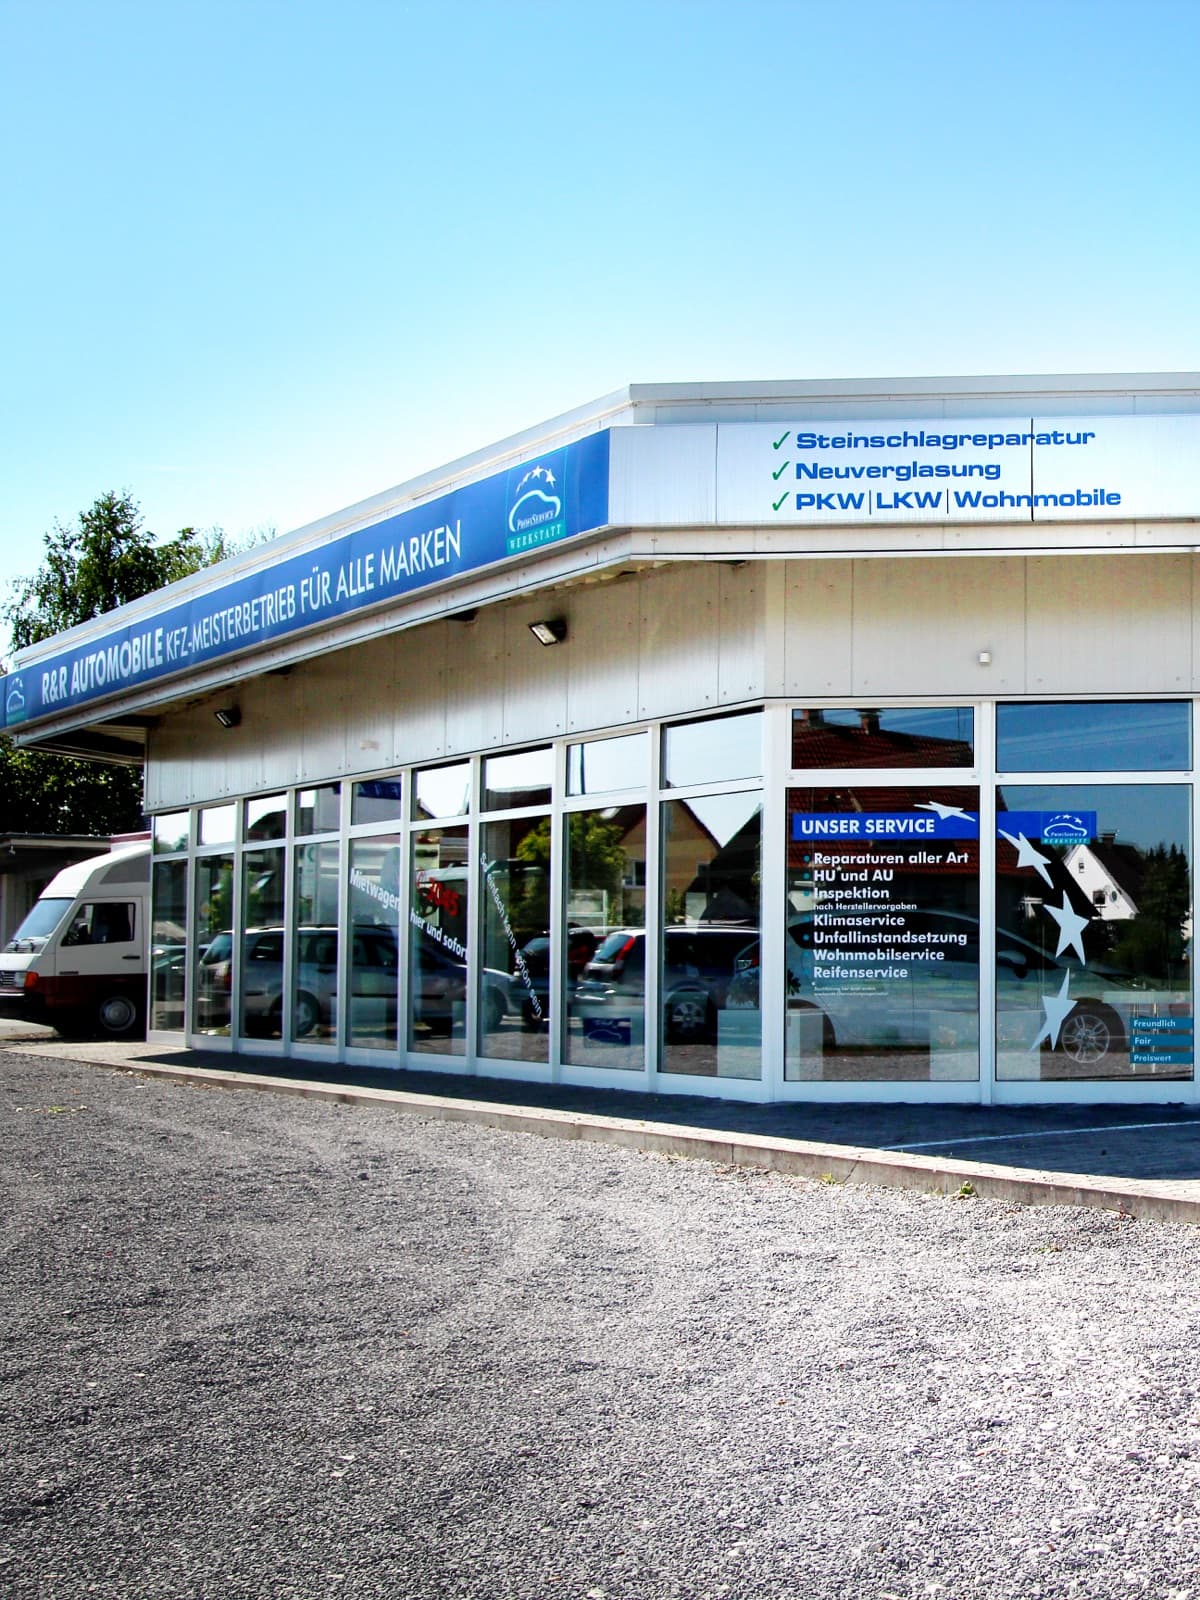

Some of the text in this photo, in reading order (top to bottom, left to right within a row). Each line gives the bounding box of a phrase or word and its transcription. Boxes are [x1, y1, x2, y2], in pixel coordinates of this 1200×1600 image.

[796, 429, 1096, 450] Steinschlagreparatur
[795, 461, 1001, 481] Neuverglasung
[795, 488, 1122, 510] PKW LKW Wohnmobile
[510, 523, 562, 549] WERKSTATT
[42, 519, 461, 704] R&R AUTOMOBILE KFZ-MEISTERBETRIEB FÜR ALLE MARKEN
[801, 819, 935, 834] UNSER SERVICE
[814, 851, 969, 867] Reparaturen aller Art
[814, 869, 894, 881] HU und AU
[350, 868, 401, 911] Mietwagen
[814, 887, 890, 901] Inspektion
[814, 902, 917, 911] nach Herstellervorgaben
[410, 907, 425, 930] hier
[426, 922, 442, 942] und
[814, 914, 905, 927] Klimaservice
[813, 930, 968, 945] Unfallinstandsetzung
[813, 948, 945, 961] Wohnmobilservice
[814, 966, 908, 979] Reifenservice
[1133, 1019, 1176, 1027] Freundlich
[1134, 1037, 1151, 1045] Fair
[1133, 1054, 1172, 1062] Preiswert
